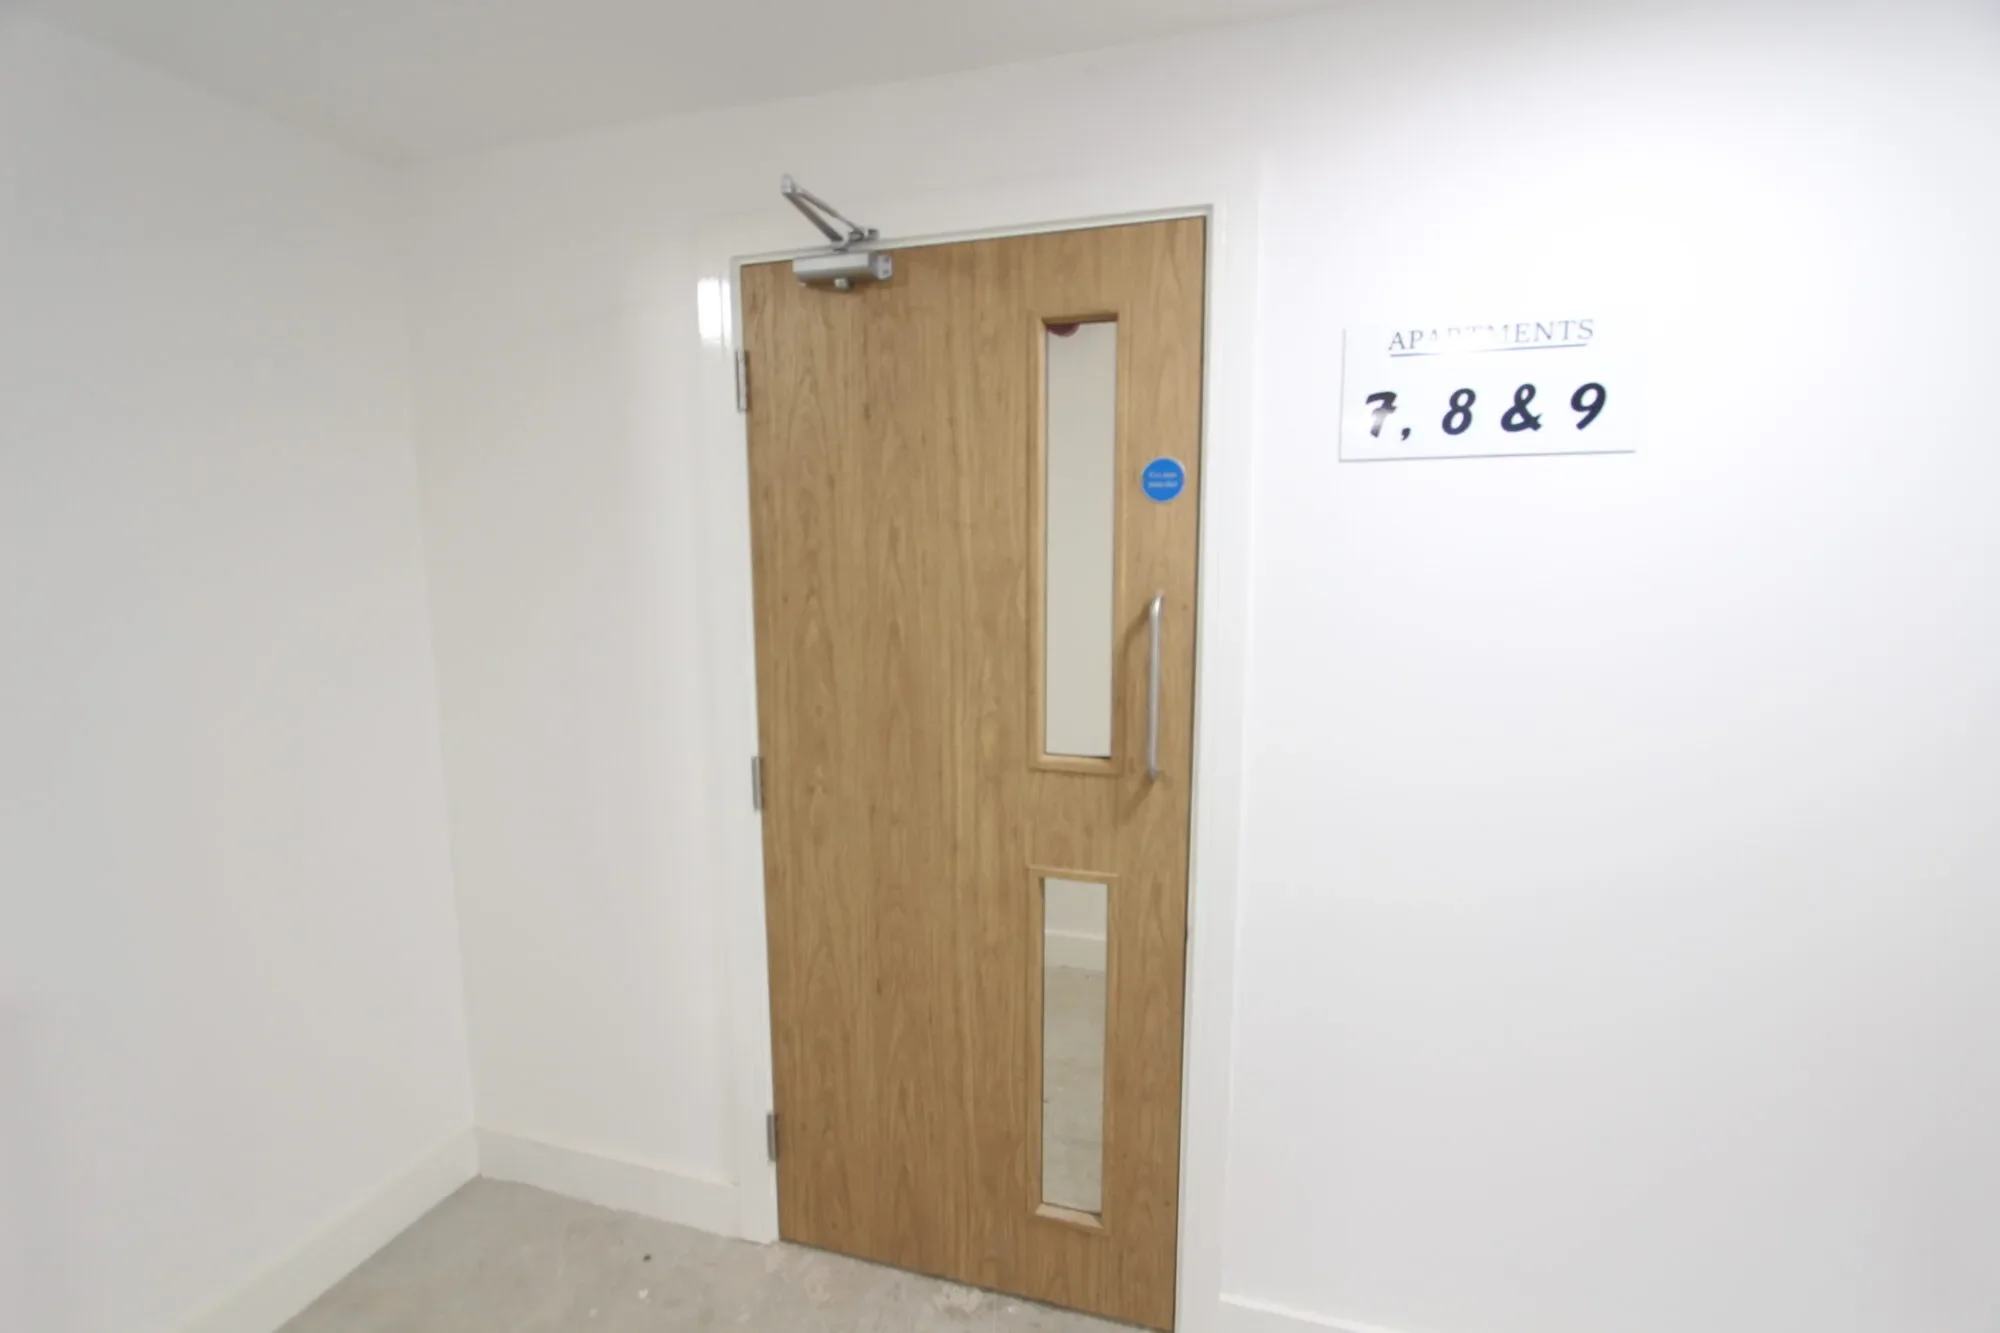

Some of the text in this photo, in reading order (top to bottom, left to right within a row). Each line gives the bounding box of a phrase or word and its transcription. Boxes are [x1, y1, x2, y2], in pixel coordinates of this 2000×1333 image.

[1388, 319, 1594, 351] APAENTS
[1365, 382, 1607, 441] 7, 8 & 9
